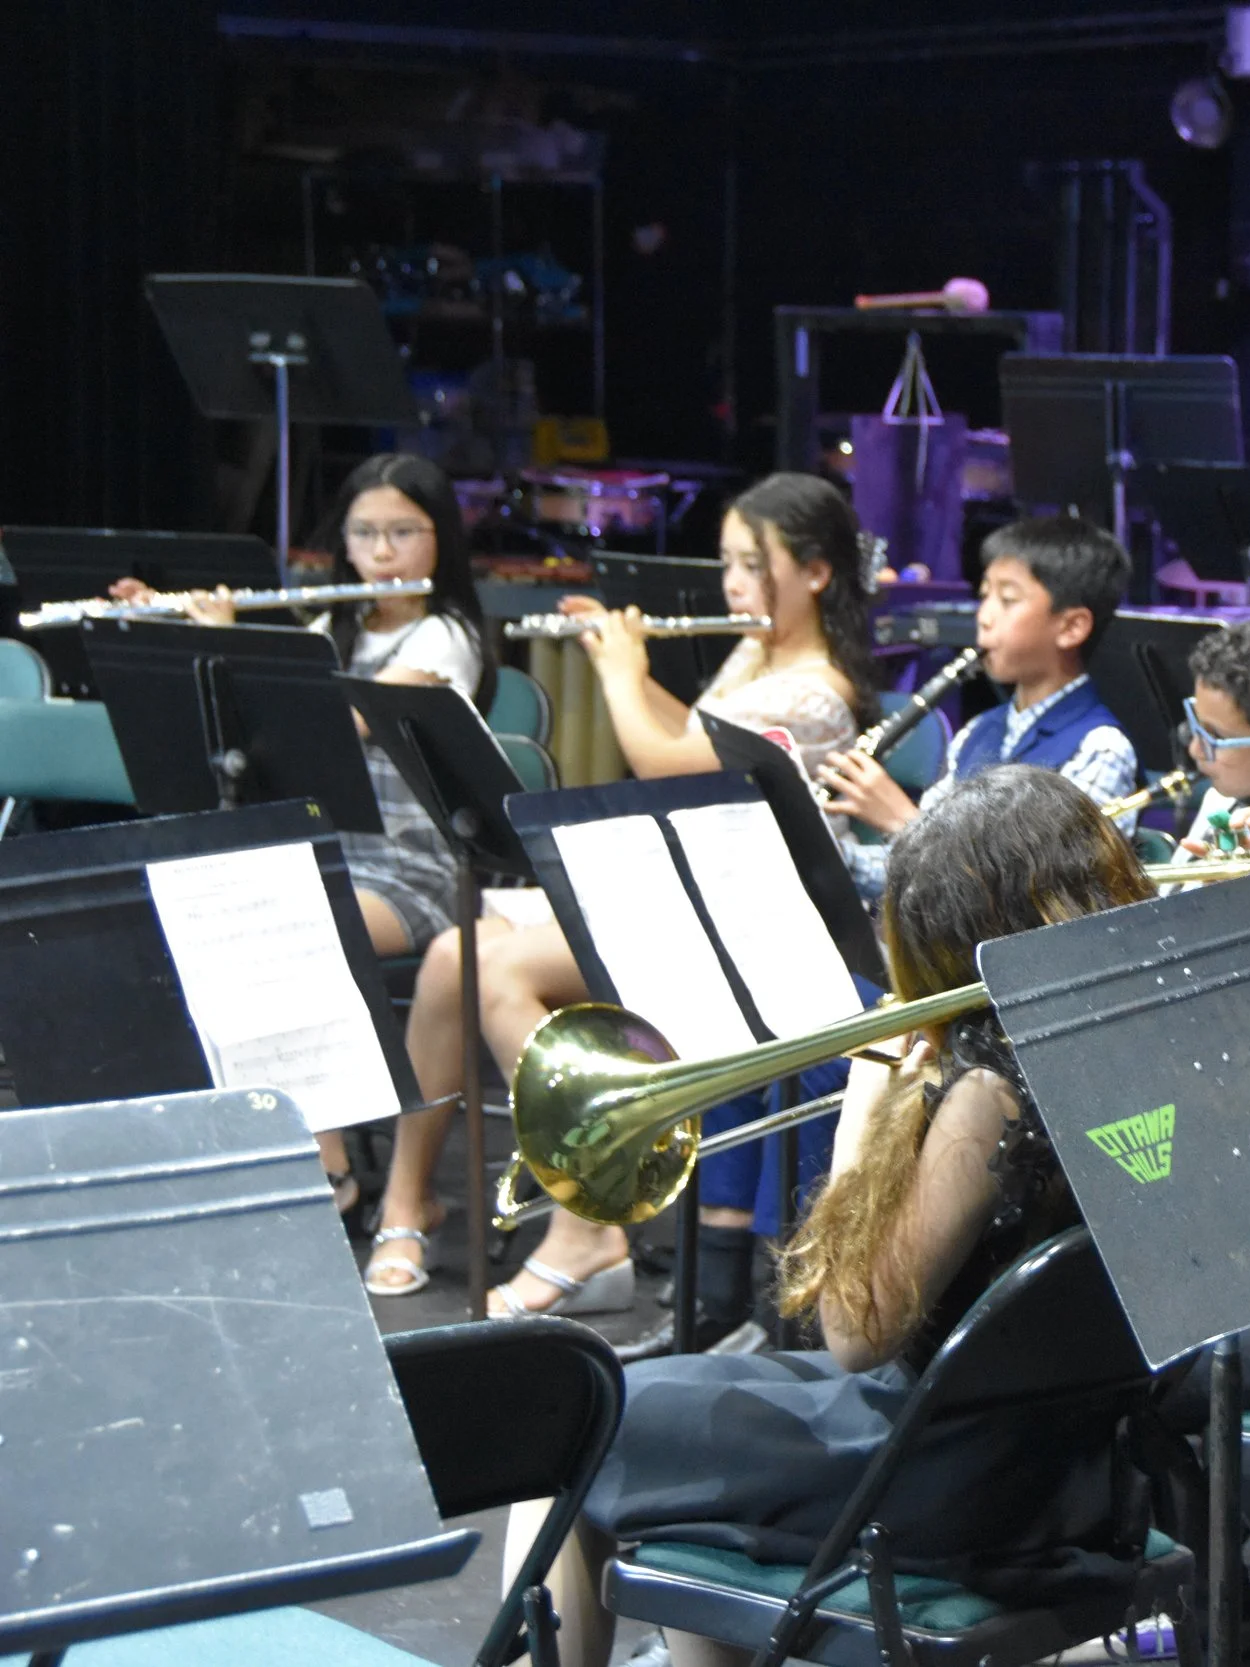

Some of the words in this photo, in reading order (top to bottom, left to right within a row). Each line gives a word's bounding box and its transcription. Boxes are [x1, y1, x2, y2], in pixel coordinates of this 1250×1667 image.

[247, 1091, 278, 1111] 30
[1085, 1103, 1176, 1158] OTTAWA
[1115, 1140, 1172, 1184] HILLS
